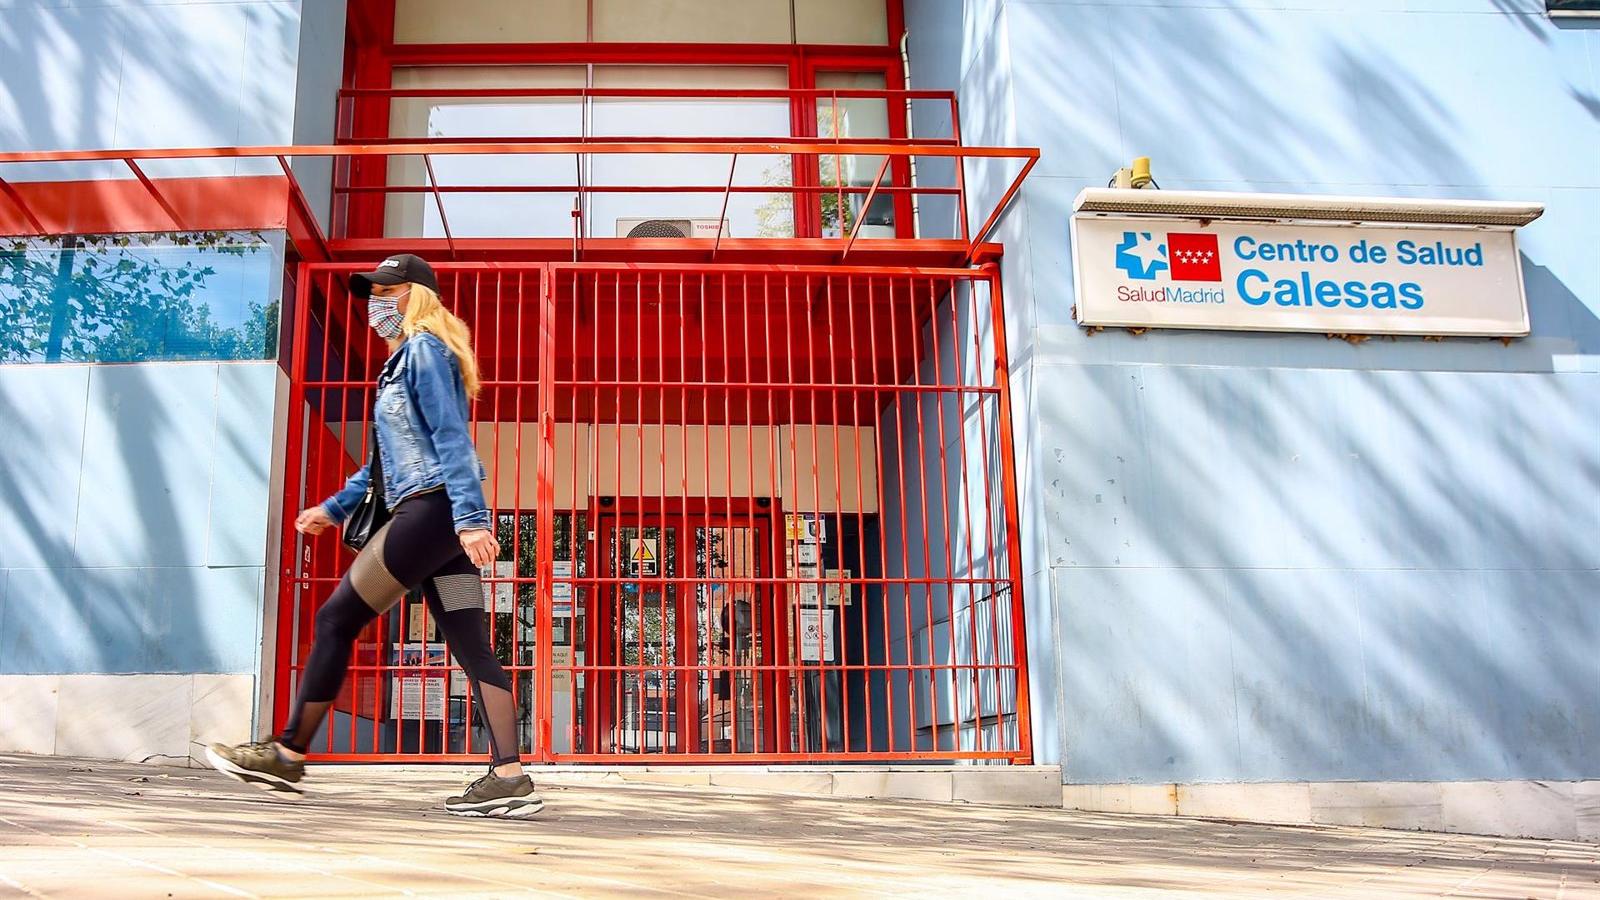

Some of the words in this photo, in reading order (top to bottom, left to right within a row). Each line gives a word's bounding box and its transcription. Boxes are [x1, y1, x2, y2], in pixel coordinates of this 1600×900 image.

[1233, 236, 1339, 263] Centro
[1349, 240, 1387, 264] de
[1396, 240, 1484, 266] Salud
[1117, 285, 1225, 304] SaludMadrid
[1236, 268, 1425, 310] Calesas
